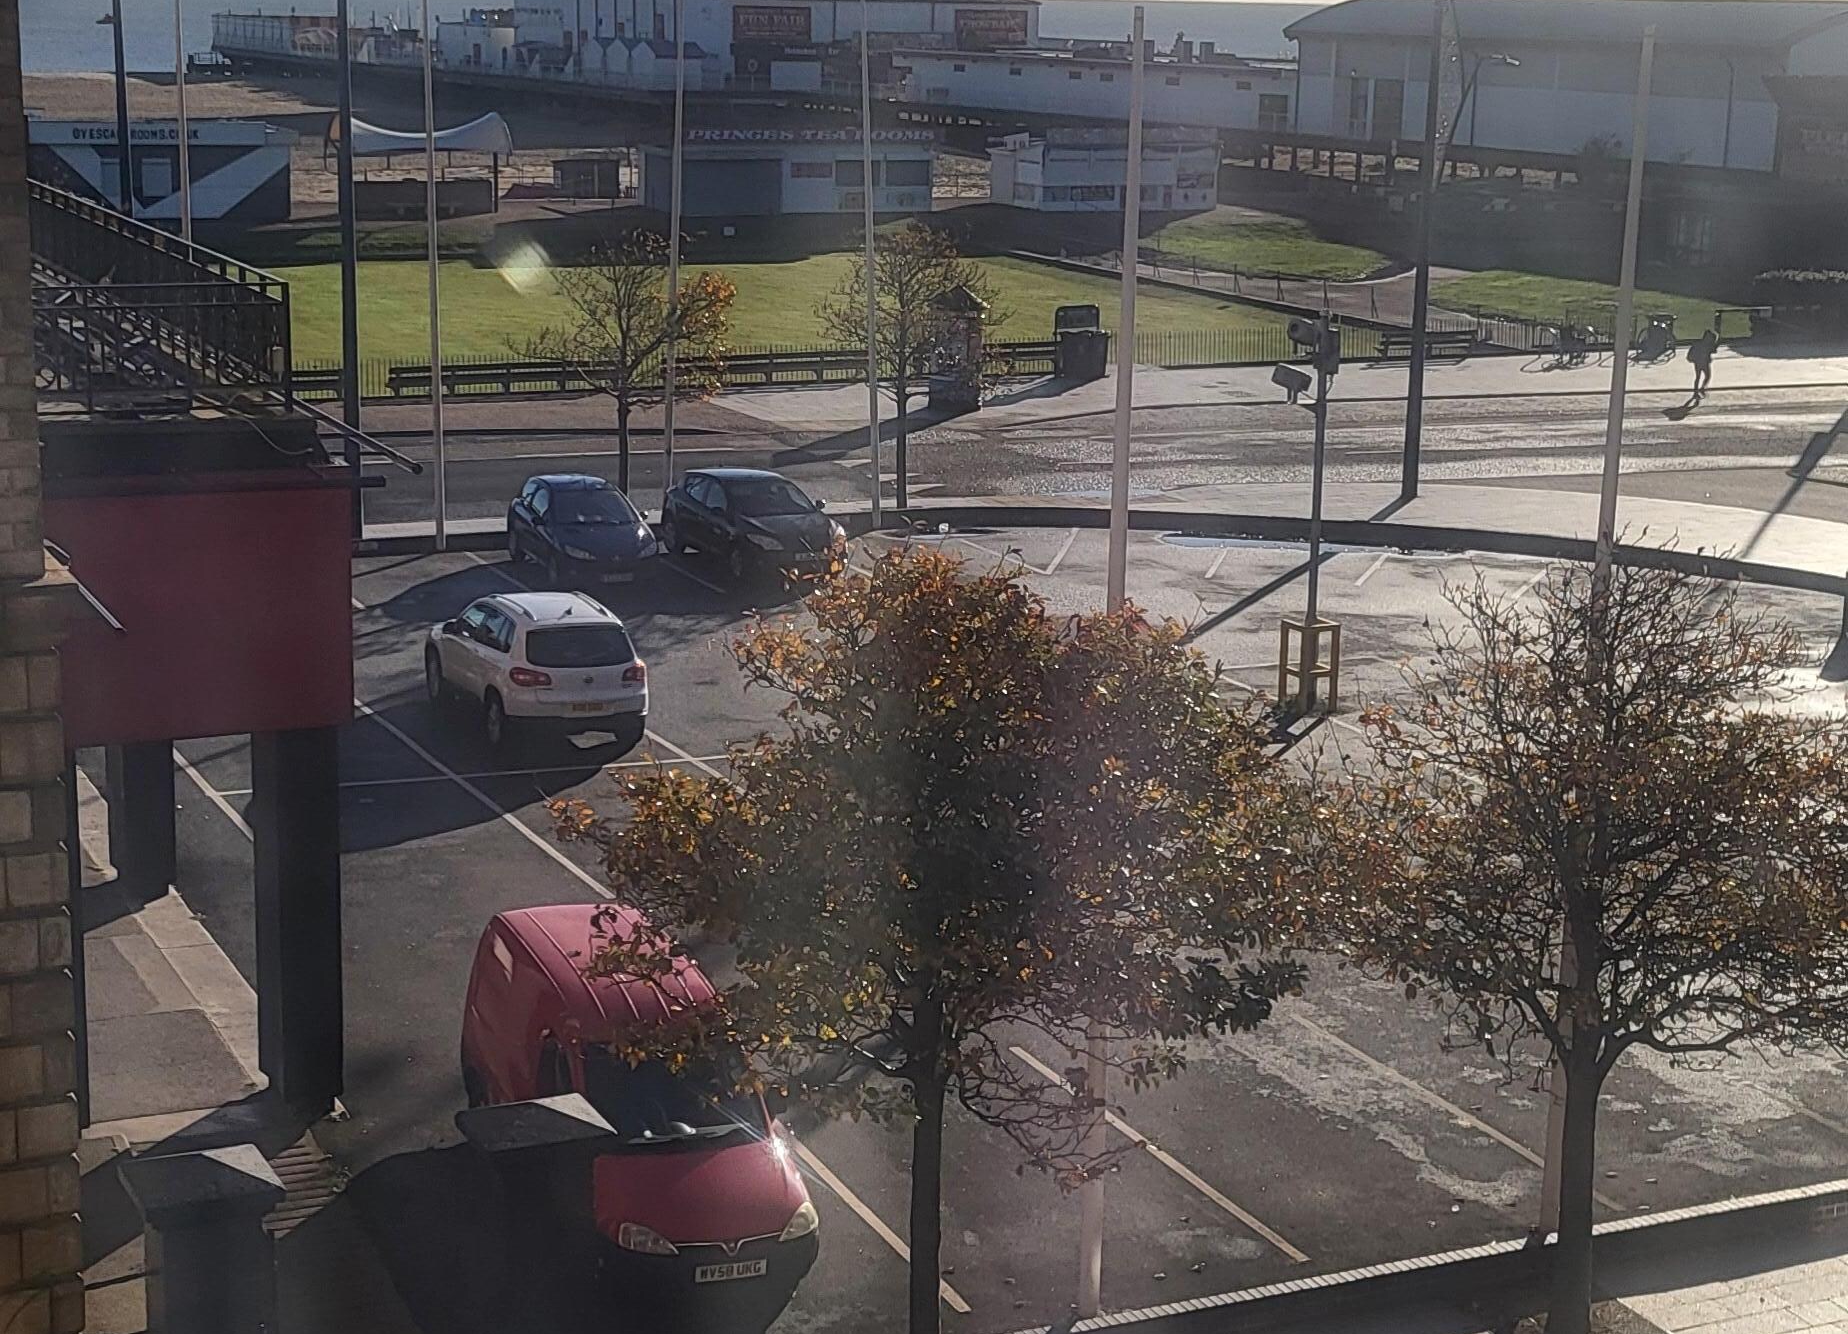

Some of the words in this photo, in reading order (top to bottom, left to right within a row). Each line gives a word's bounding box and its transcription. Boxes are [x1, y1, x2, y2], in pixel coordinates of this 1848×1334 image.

[739, 14, 770, 26] FUN
[773, 14, 805, 26] FAIR
[801, 129, 848, 141] TEA
[736, 1261, 762, 1276] UKG
